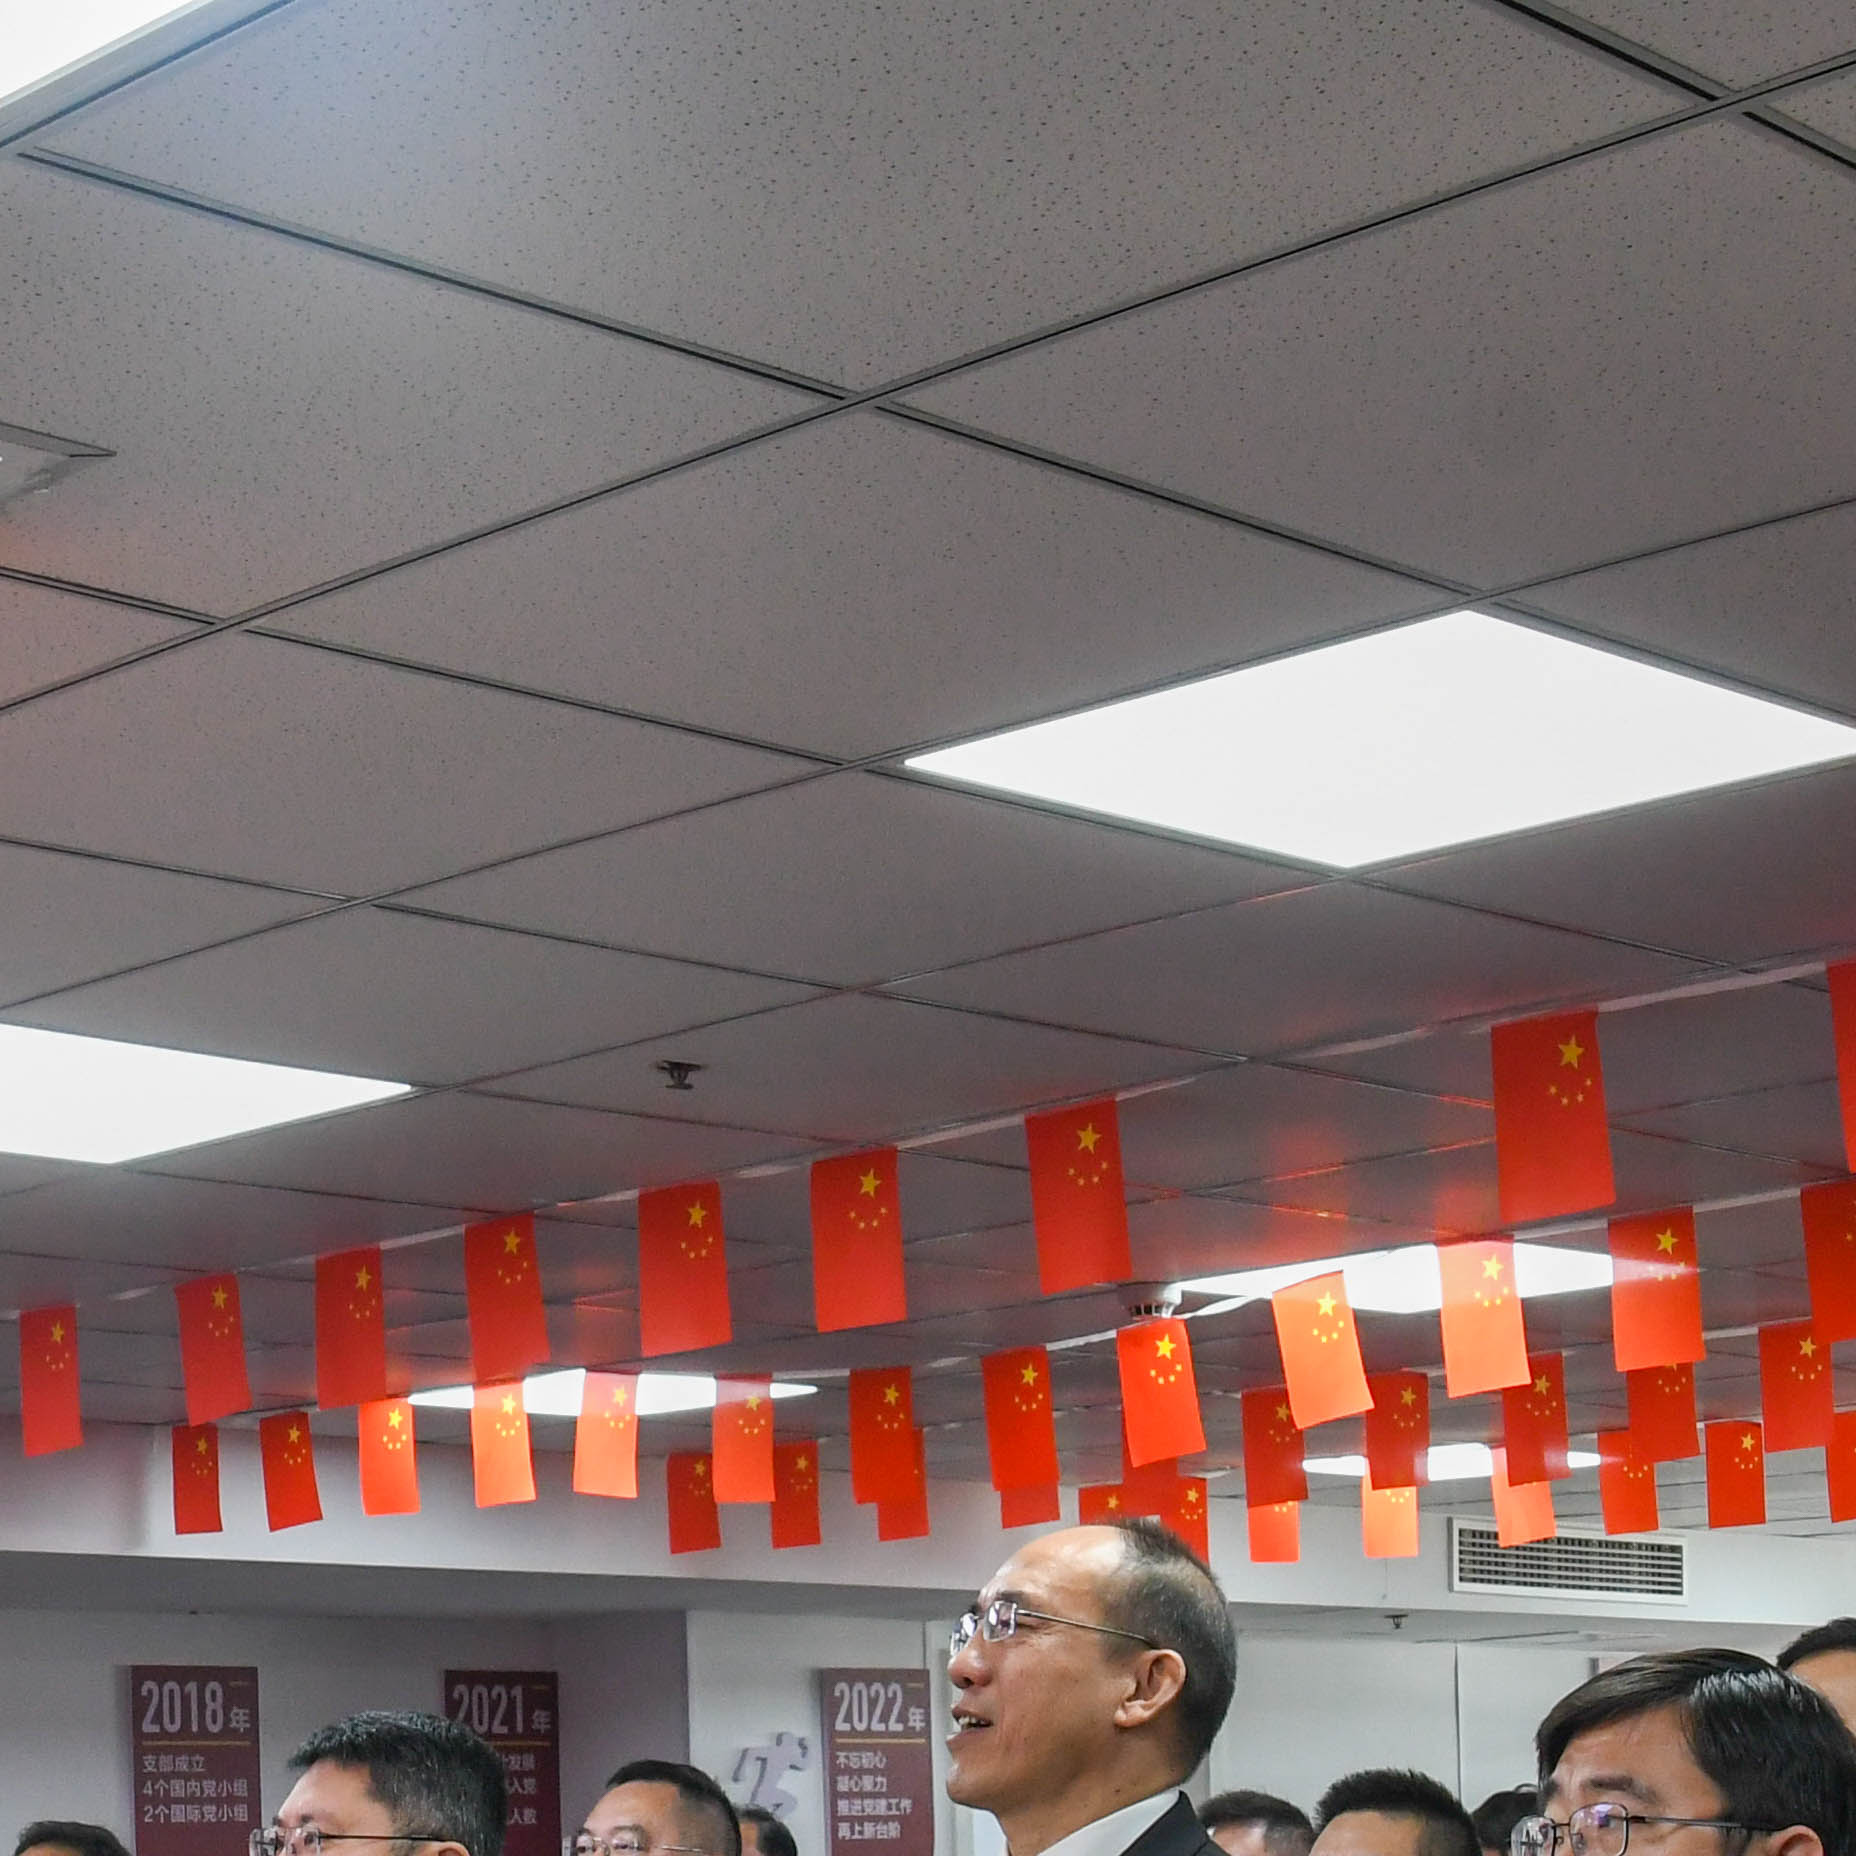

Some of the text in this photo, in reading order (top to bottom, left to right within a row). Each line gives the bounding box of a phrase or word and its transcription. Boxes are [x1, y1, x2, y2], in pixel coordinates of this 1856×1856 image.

[141, 1680, 251, 1733] 2018年
[834, 1681, 926, 1733] 2022年
[143, 1754, 206, 1773] 支部成立
[143, 1779, 248, 1798] 4个国内党小组
[144, 1804, 248, 1824] 2个国际党小组
